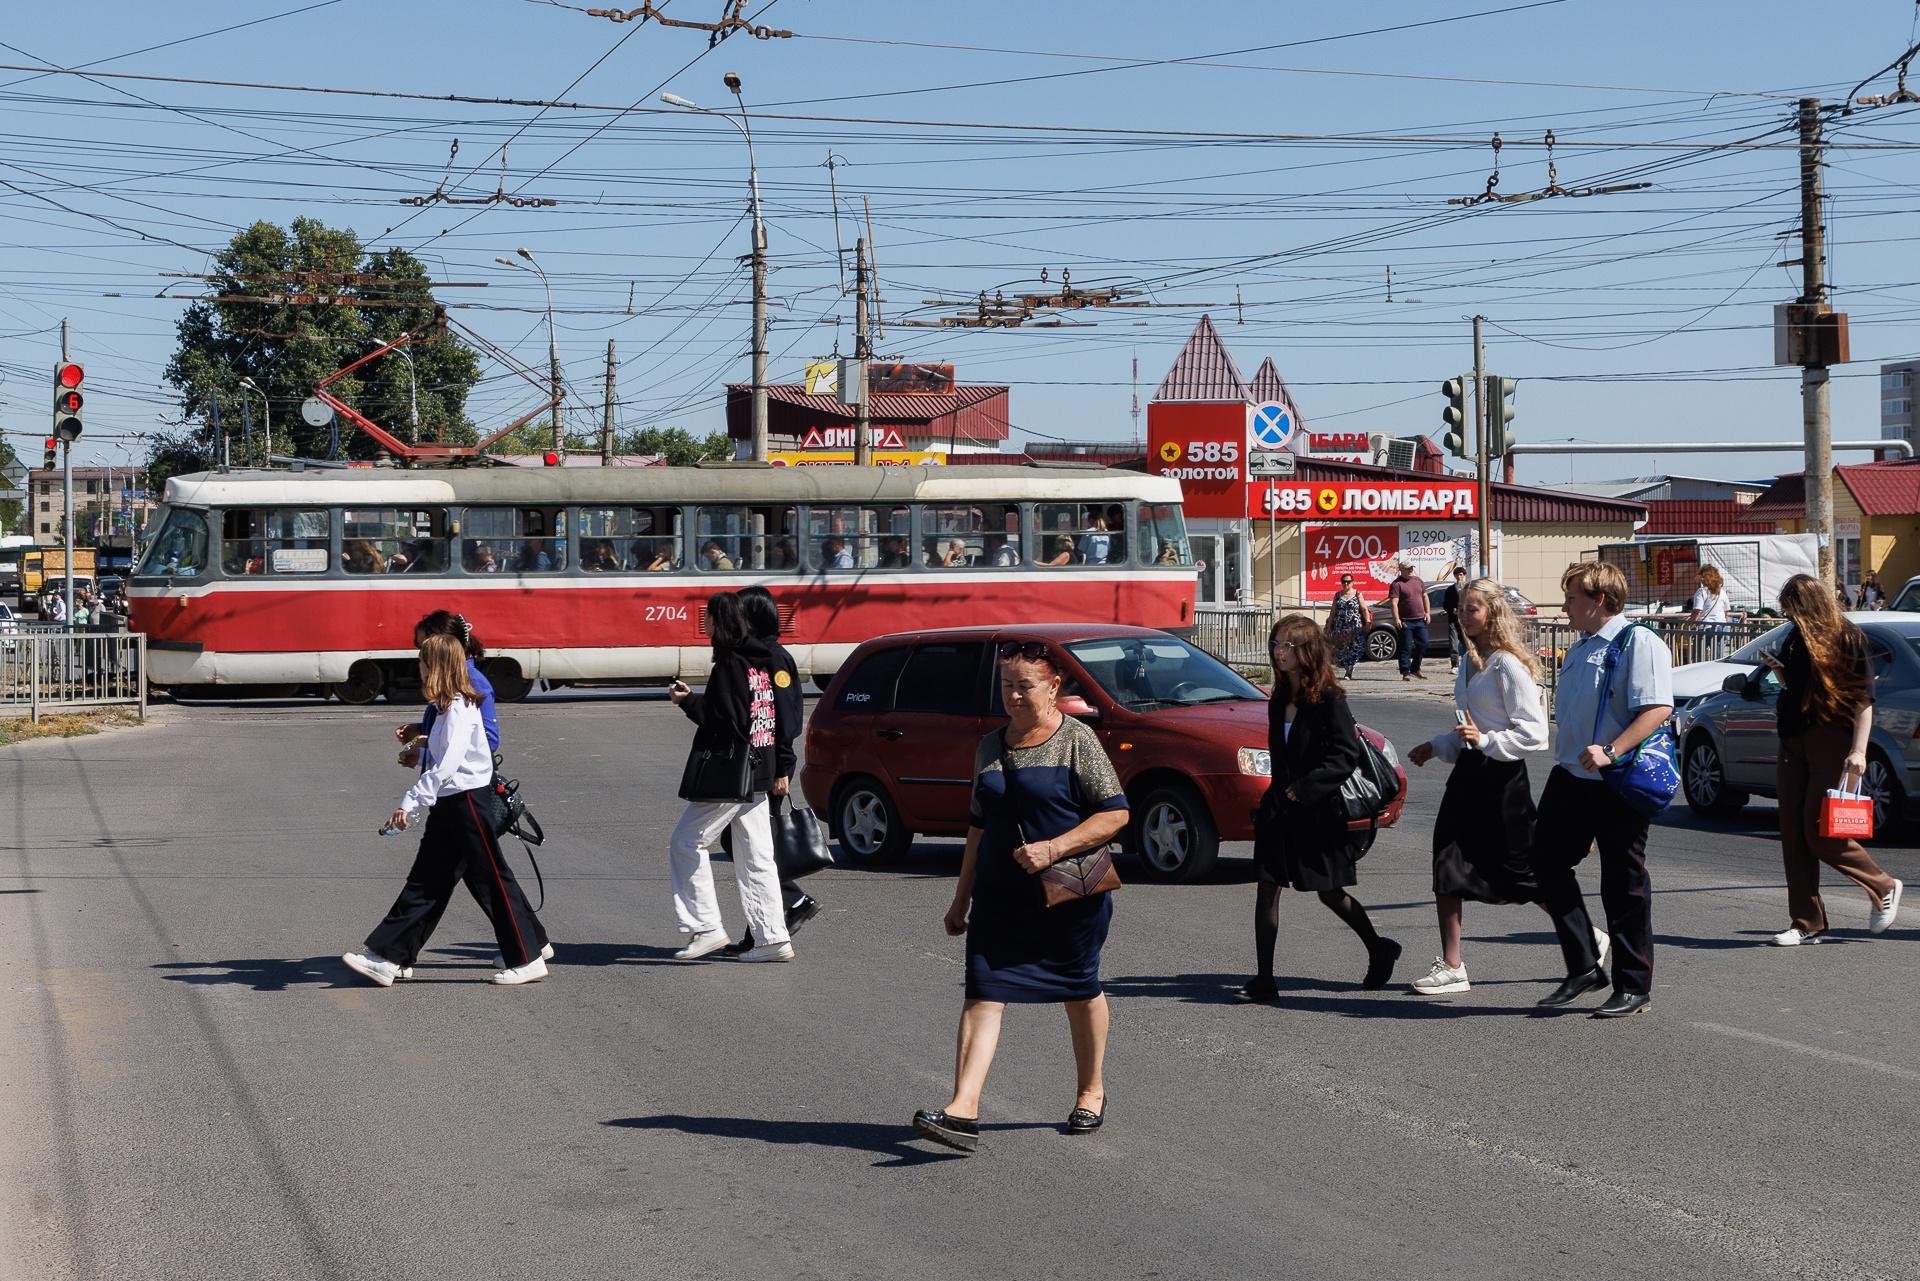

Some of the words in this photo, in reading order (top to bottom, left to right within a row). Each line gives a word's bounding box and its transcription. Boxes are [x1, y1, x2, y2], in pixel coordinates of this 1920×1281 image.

[69, 394, 79, 410] 6
[1187, 441, 1239, 463] 585
[1160, 467, 1239, 480] ЗОЛОТОЙ
[1263, 488, 1312, 511] 585
[1342, 489, 1474, 515] ЛОМБАРД
[1406, 547, 1446, 556] ЗОЛОТО
[645, 606, 688, 621] 2704
[846, 692, 871, 702] Pride
